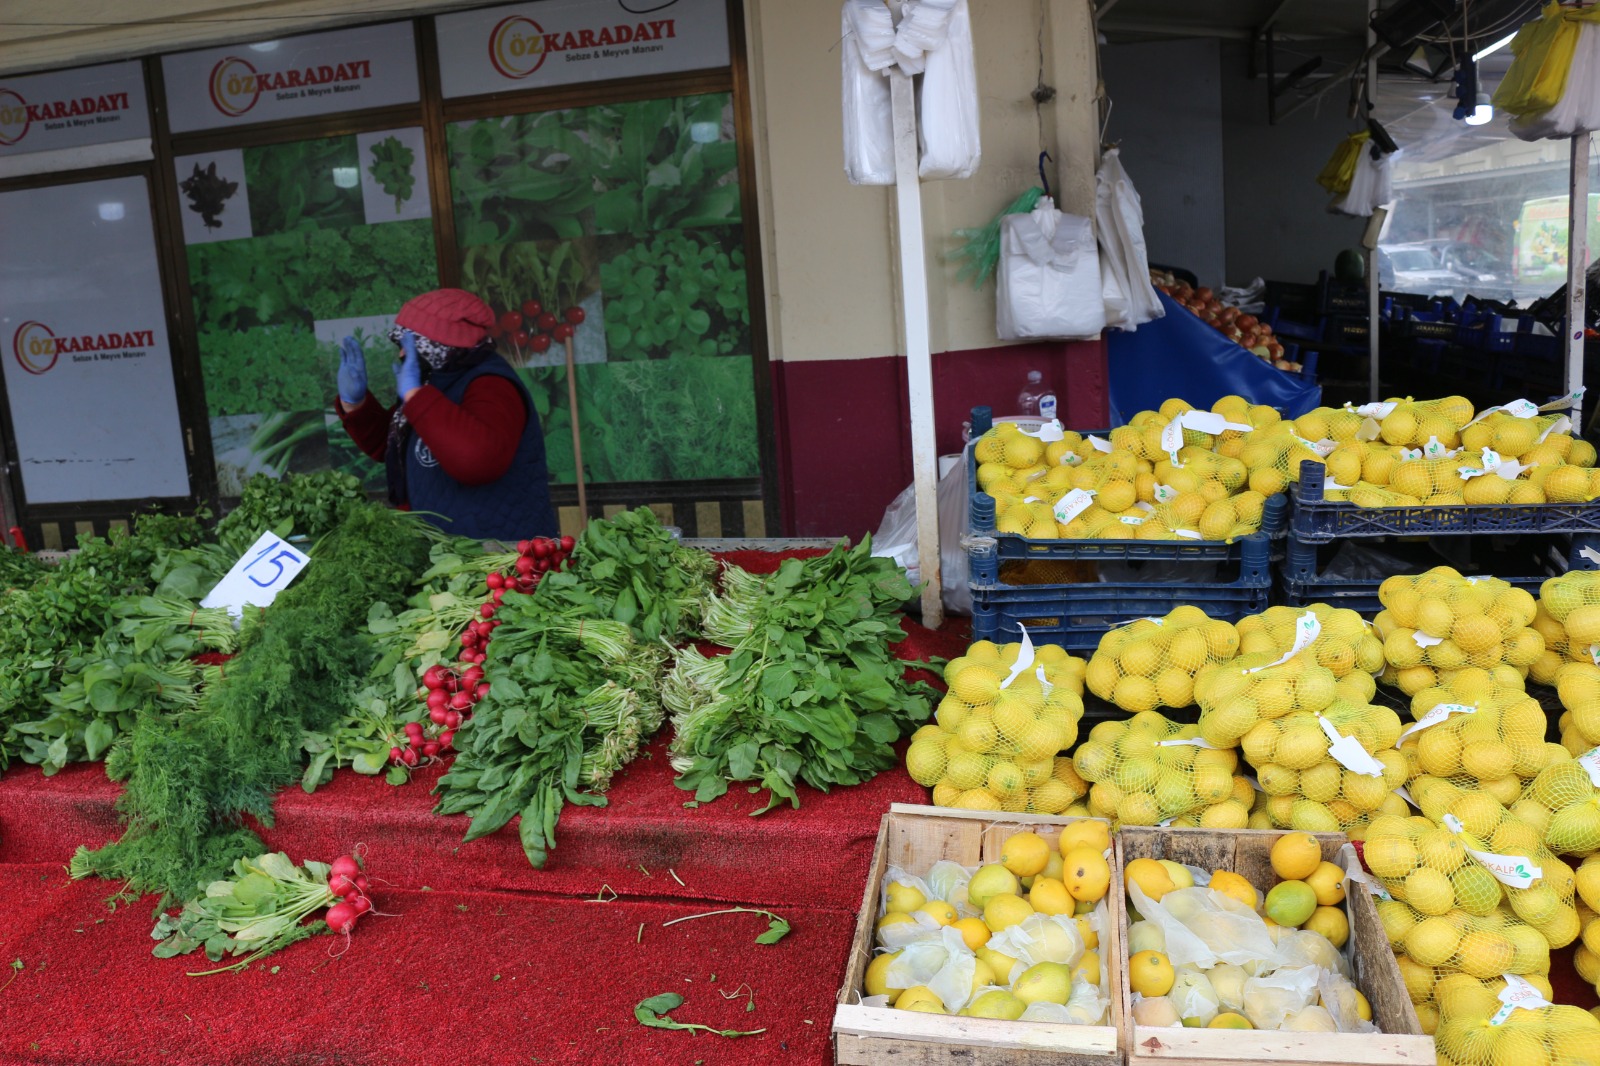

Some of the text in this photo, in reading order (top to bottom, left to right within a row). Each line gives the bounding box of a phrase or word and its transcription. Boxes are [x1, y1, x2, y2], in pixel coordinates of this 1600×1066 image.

[565, 45, 664, 62] Sebze & Meyve Manavı
[276, 92, 298, 101] Sebze
[300, 90, 306, 98] &
[308, 88, 332, 97] Meyve
[66, 120, 72, 128] &
[243, 541, 301, 588] 15
